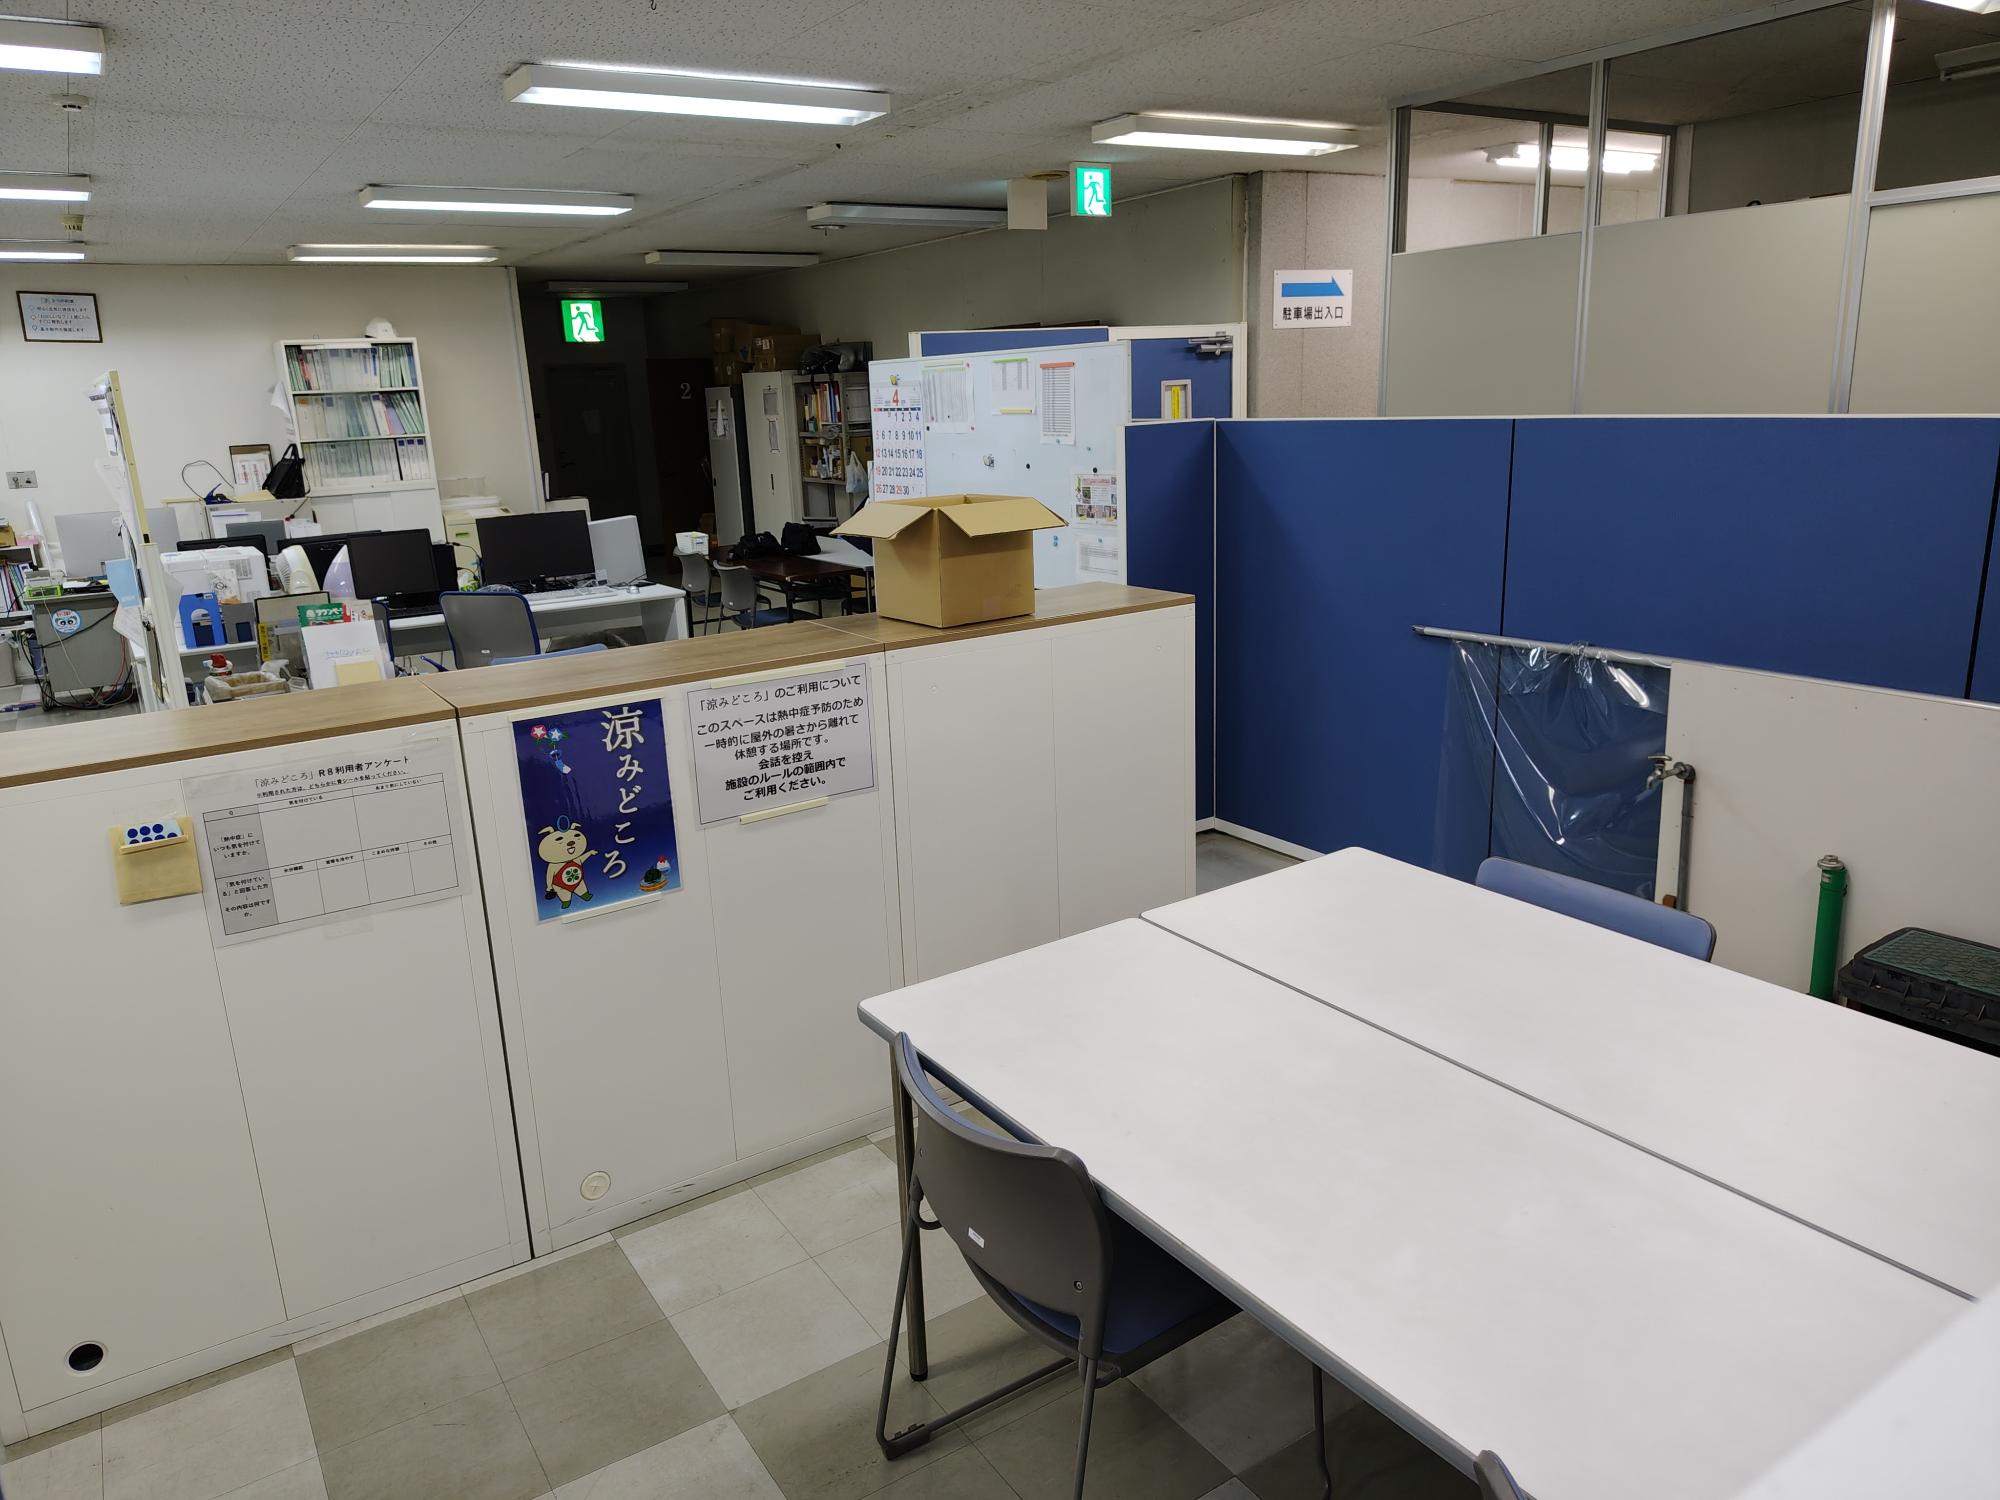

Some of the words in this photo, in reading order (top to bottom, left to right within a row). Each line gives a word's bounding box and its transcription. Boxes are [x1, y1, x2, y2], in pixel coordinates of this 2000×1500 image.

[1282, 306, 1343, 321] 駐車場出入口
[680, 382, 692, 399] 2
[892, 389, 899, 406] 4
[901, 411, 905, 422] 2
[908, 411, 913, 422] 3
[915, 411, 920, 422] 4
[876, 429, 880, 440] 5
[881, 430, 886, 441] 6
[888, 430, 892, 441] 7
[894, 430, 899, 441] 8
[901, 430, 906, 441] 9
[908, 430, 915, 441] 10
[915, 430, 922, 441] 11
[875, 448, 881, 458] 12
[881, 448, 888, 459] 13
[888, 448, 894, 459] 14
[894, 448, 901, 459] 15
[901, 448, 908, 460] 16
[908, 448, 915, 460] 17
[916, 448, 923, 460] 18
[876, 465, 881, 476] 19
[881, 466, 888, 477] 20
[888, 466, 895, 477] 21
[895, 466, 902, 477] 22
[902, 466, 909, 478] 23
[908, 467, 916, 478] 24
[916, 467, 924, 479] 25
[876, 484, 882, 494] 26
[882, 484, 889, 494] 27
[889, 484, 896, 495] 28
[896, 484, 903, 495] 29
[902, 485, 910, 496] 30
[699, 675, 862, 711] 「涼みどころ」のご利用について
[697, 696, 864, 736] このスペースは熱中症予防のため
[704, 713, 859, 750] 一時的に屋外の暑さから離れて
[734, 733, 830, 761] 休憩する場所です。
[758, 750, 814, 770] 会話を控え
[725, 756, 847, 791] 施設のルールの範囲内で
[601, 706, 645, 879] 涼みどころ
[743, 777, 827, 801] ご利用ください。
